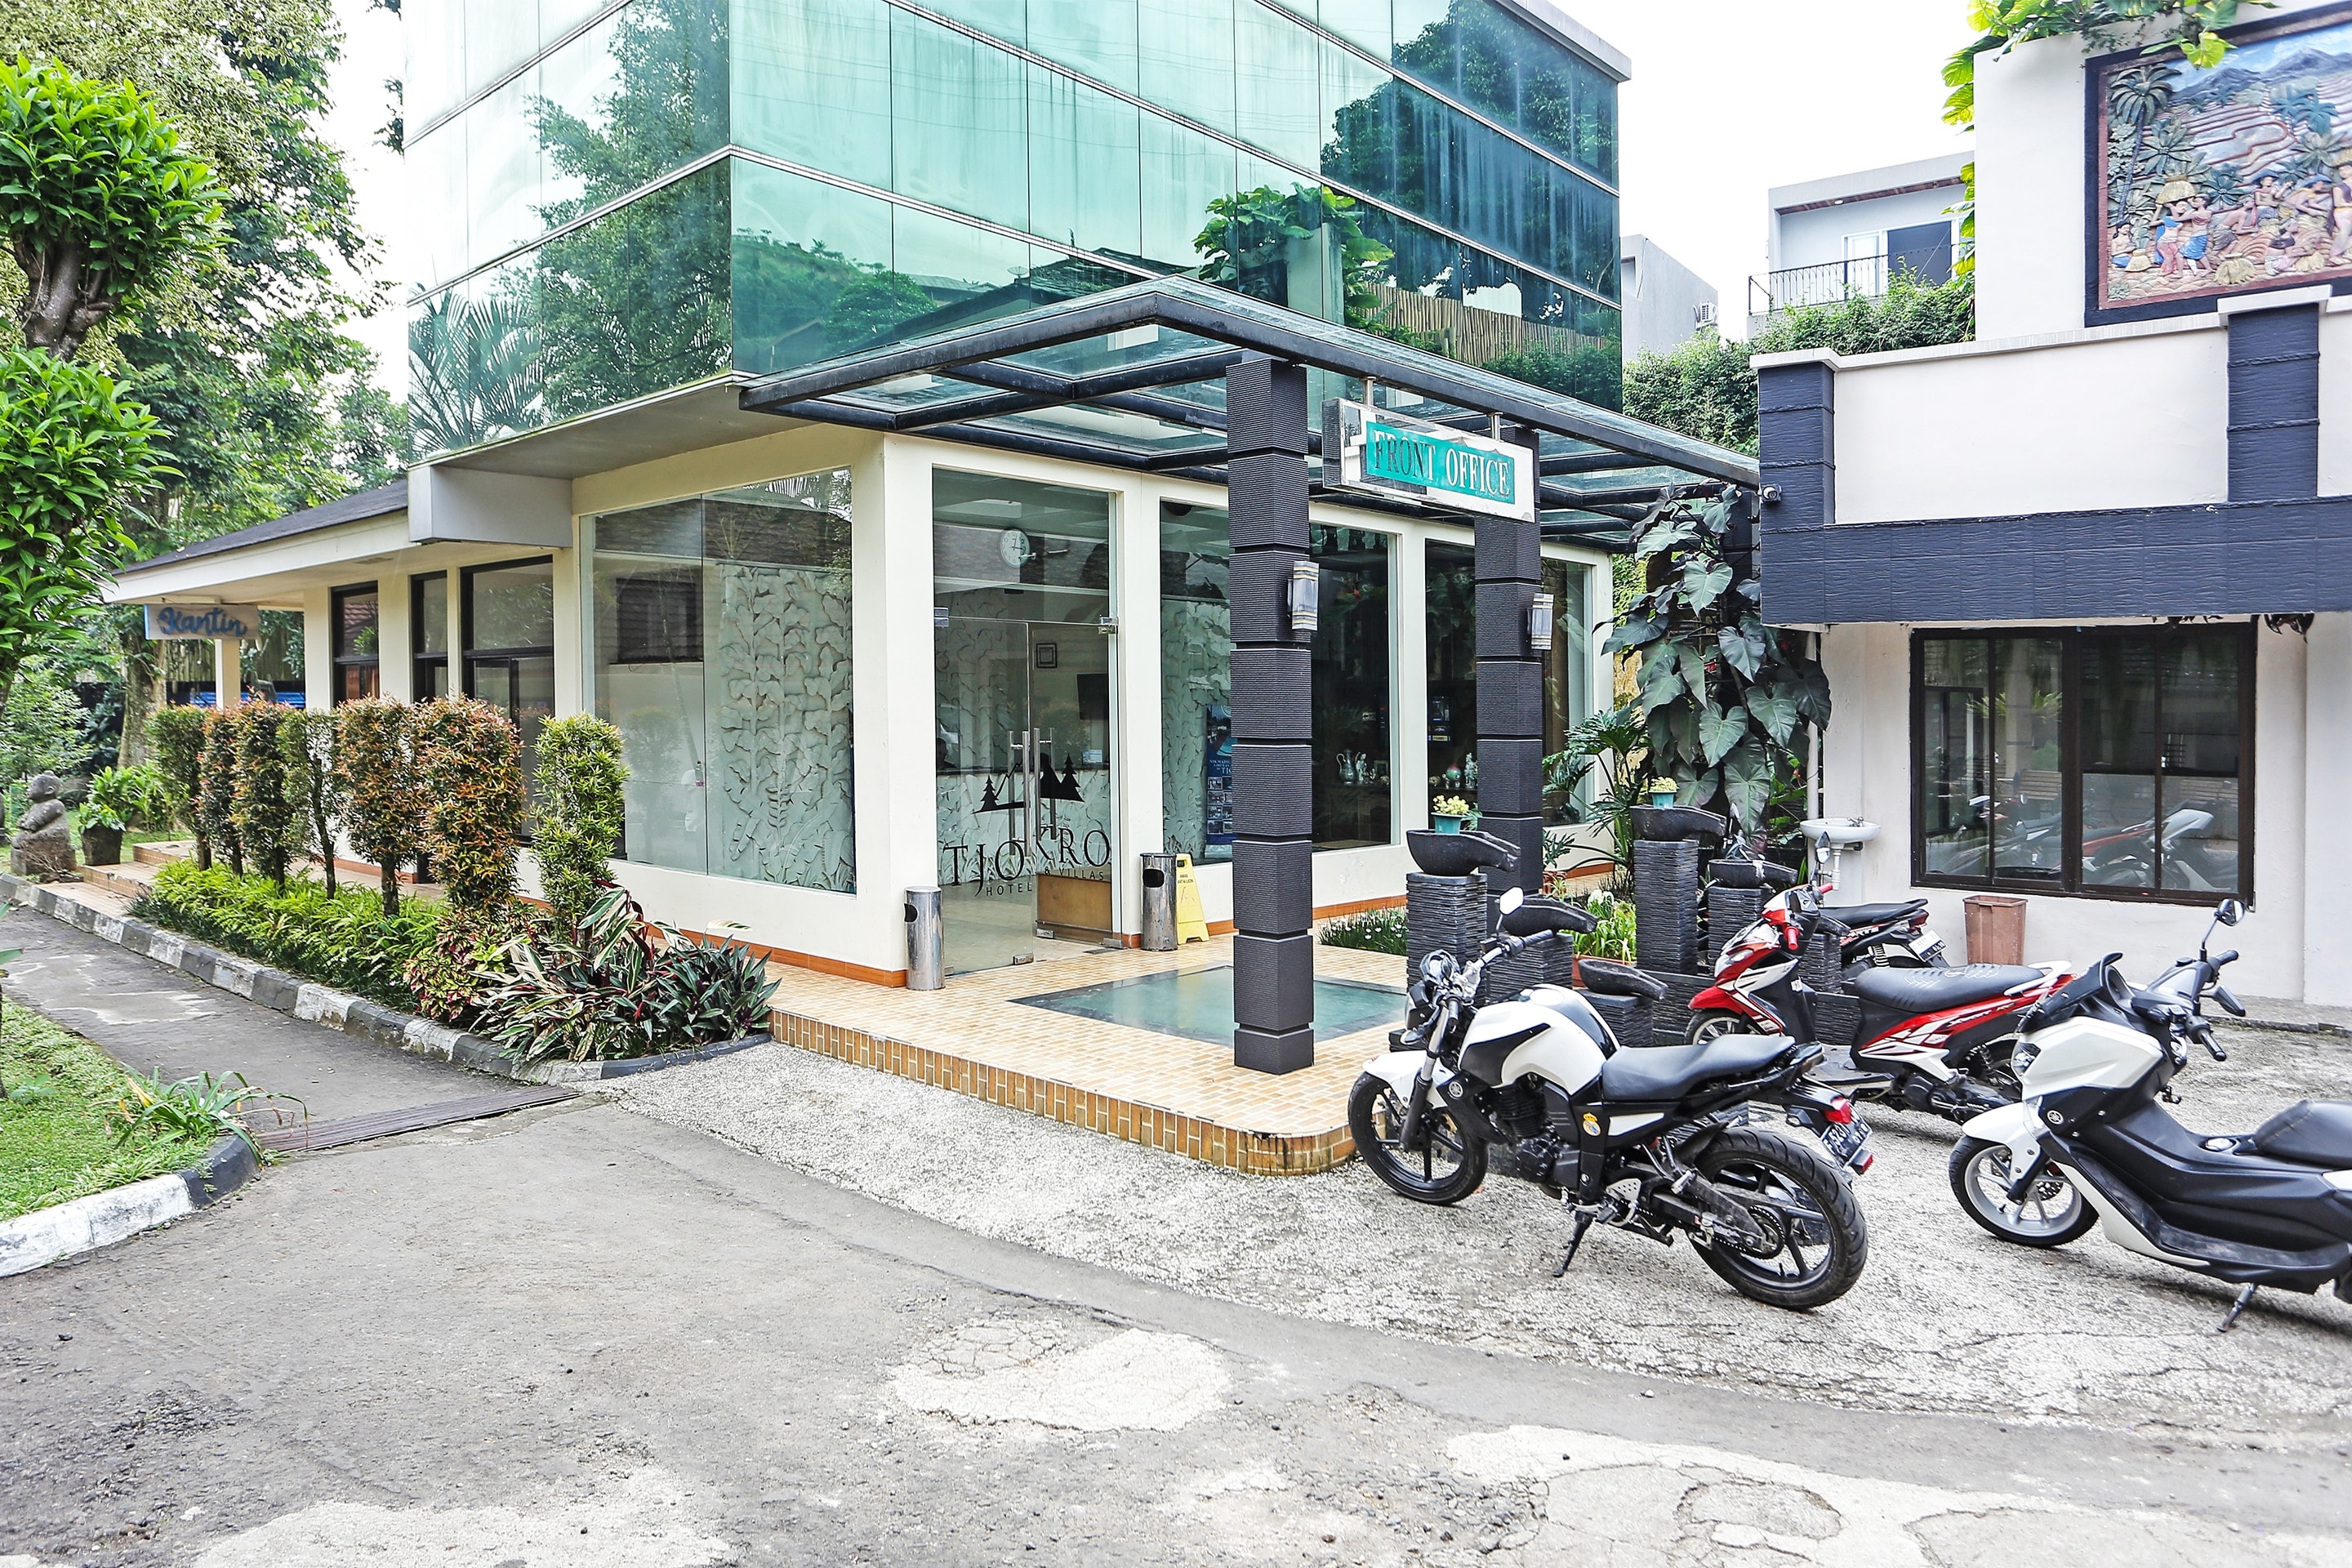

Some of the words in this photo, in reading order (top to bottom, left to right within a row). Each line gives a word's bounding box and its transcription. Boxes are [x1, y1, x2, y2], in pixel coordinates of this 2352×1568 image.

[1373, 430, 1437, 481] FRONT
[1445, 448, 1510, 497] OFFICE
[156, 607, 247, 637] Kantin
[986, 882, 1033, 897] HOTEL
[1044, 867, 1051, 876] &
[1058, 868, 1104, 881] VILLAS
